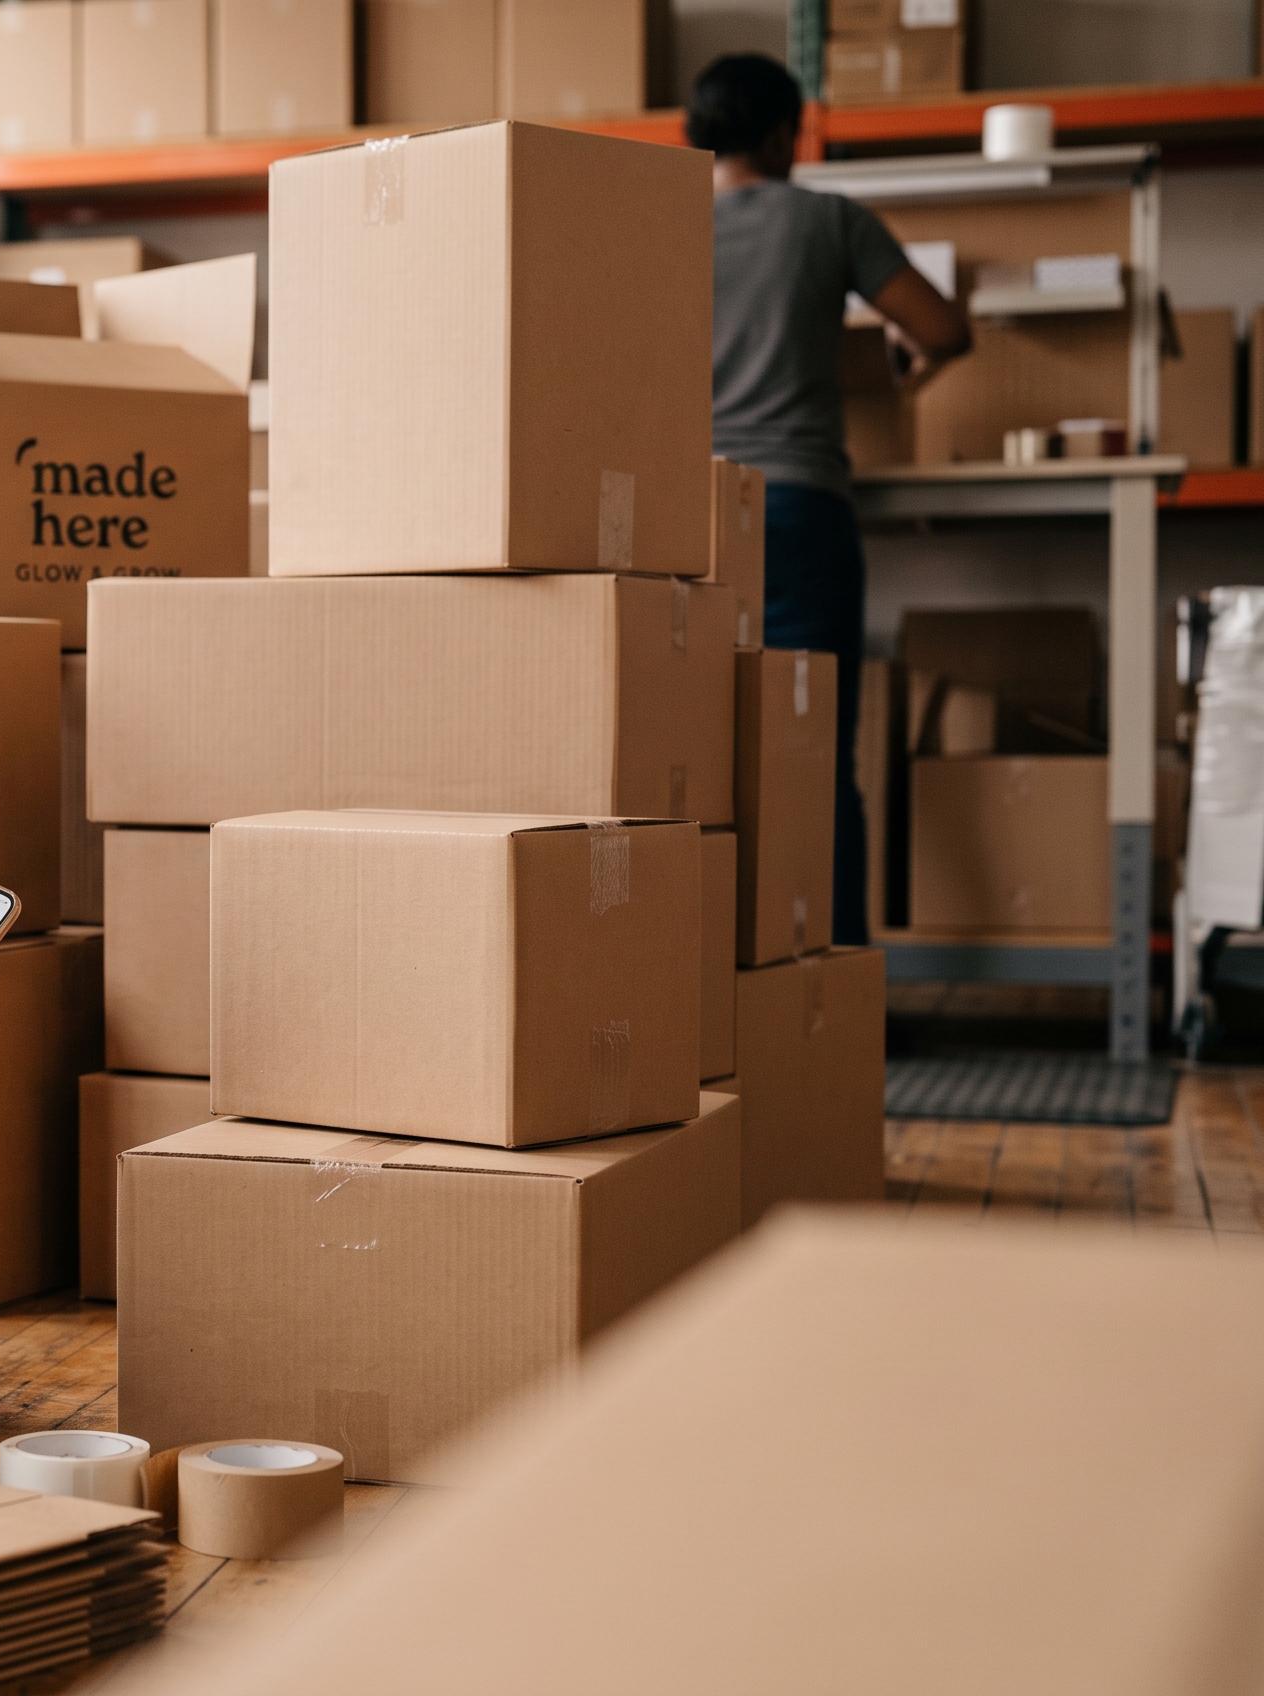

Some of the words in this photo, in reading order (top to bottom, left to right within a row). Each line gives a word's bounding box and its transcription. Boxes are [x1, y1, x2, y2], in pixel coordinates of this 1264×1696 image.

[32, 451, 177, 499] made
[32, 499, 149, 550] here
[15, 563, 83, 582] GLOW
